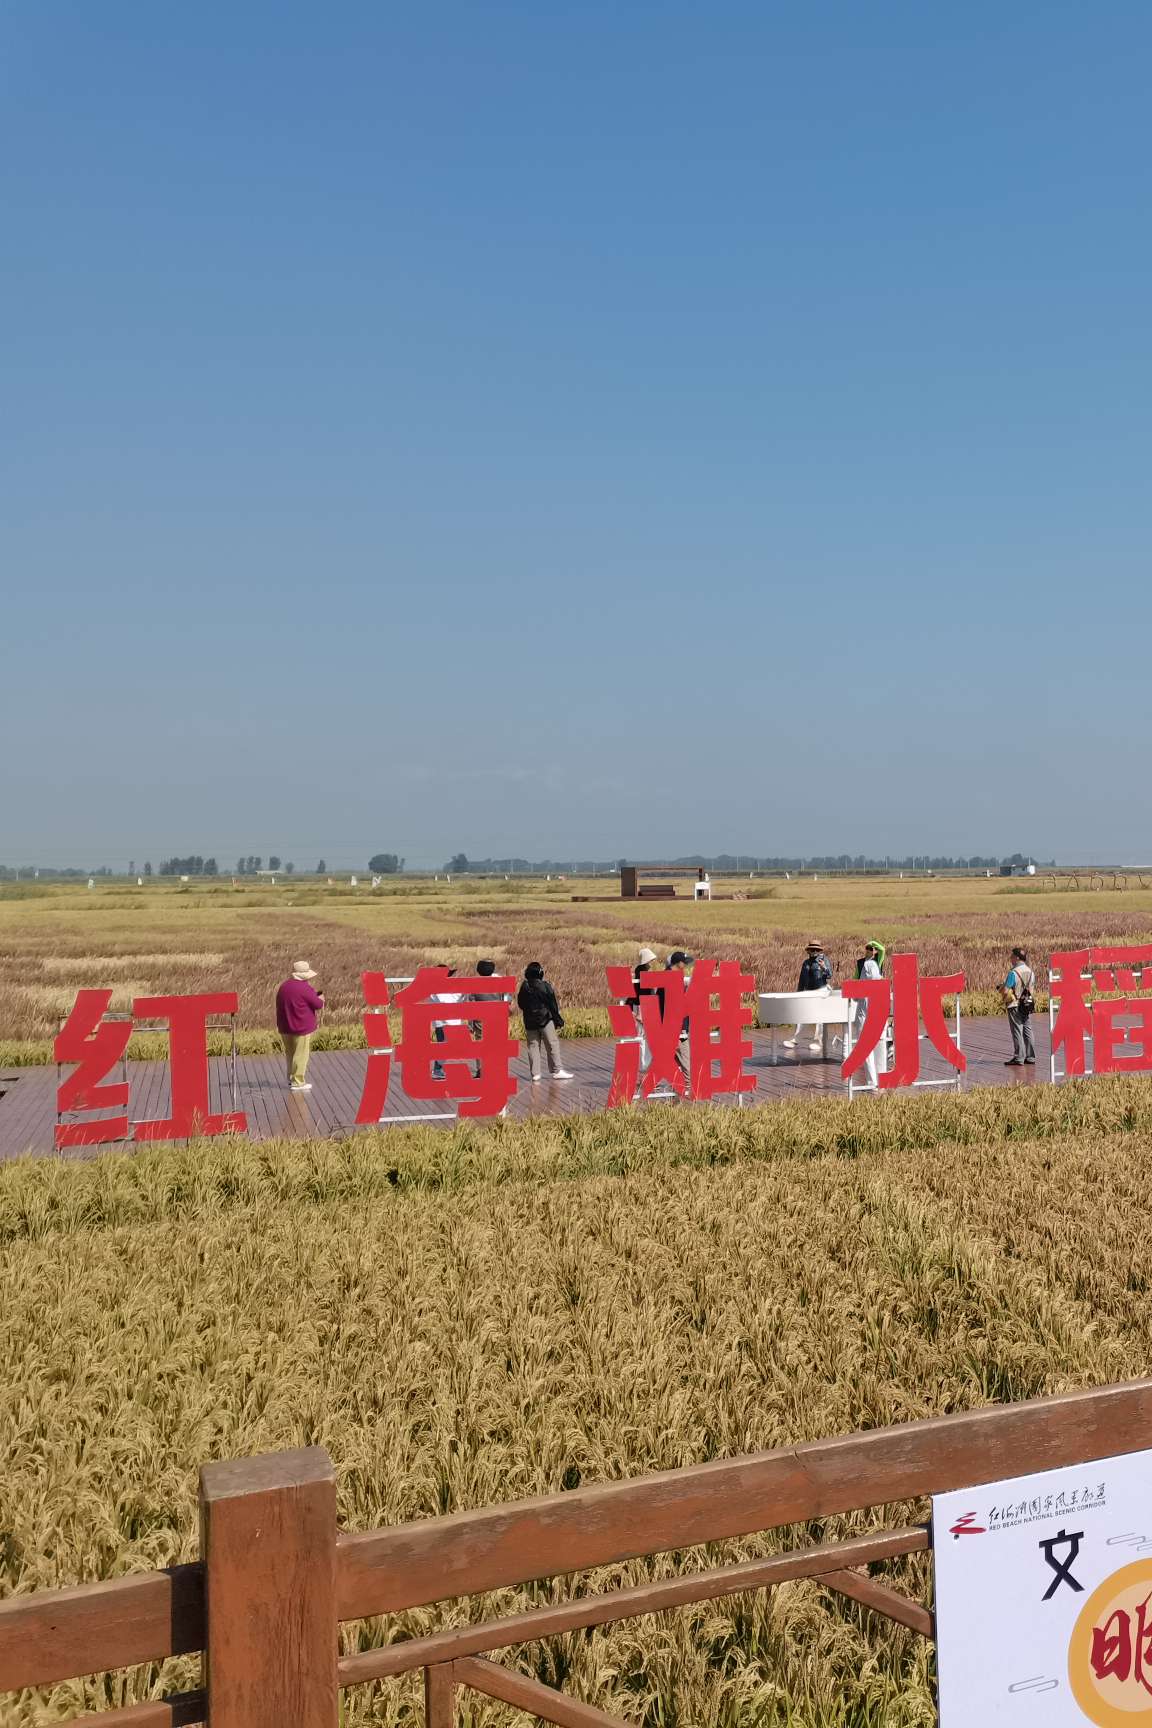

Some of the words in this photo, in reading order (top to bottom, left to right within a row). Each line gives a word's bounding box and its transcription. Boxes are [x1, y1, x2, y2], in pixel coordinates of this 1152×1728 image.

[989, 1523, 1001, 1531] RED
[1002, 1518, 1022, 1529] BEACH
[1023, 1512, 1053, 1524] NATIONAL
[1054, 1506, 1076, 1517] SCENIC
[1076, 1500, 1106, 1512] CORRIDOR
[1038, 1528, 1085, 1601] 文
